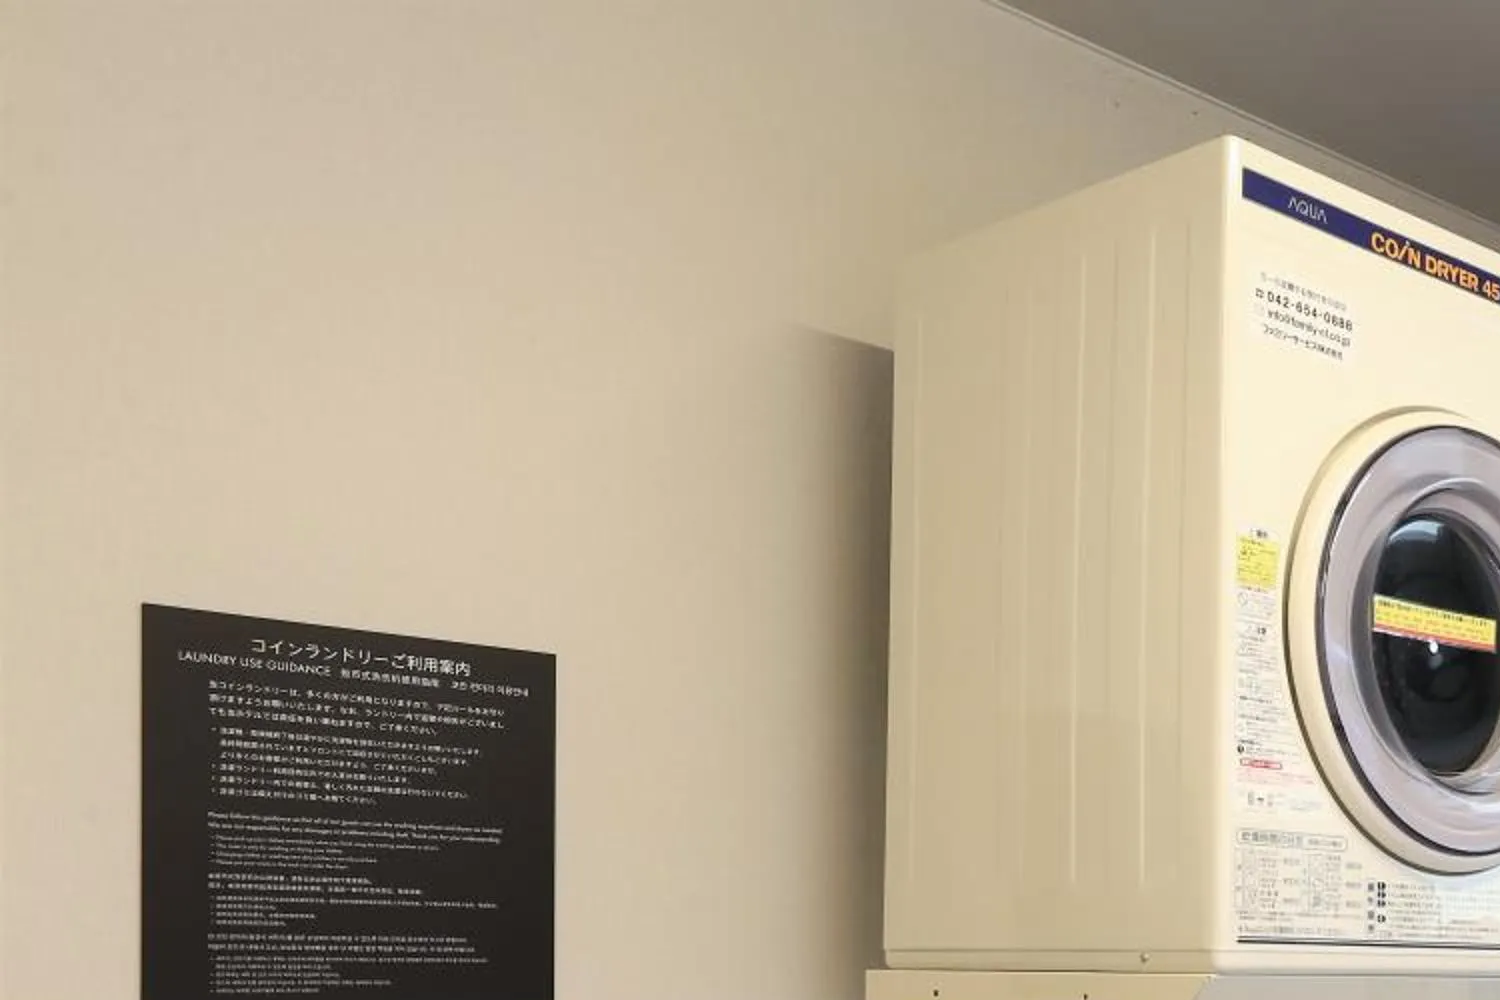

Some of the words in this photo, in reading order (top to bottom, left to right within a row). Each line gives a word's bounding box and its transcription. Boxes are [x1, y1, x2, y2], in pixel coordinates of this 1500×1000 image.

[1287, 196, 1328, 224] AQUA
[1425, 255, 1479, 291] DRYER
[1482, 279, 1500, 301] 45
[177, 650, 238, 666] LAUNDRY
[239, 657, 263, 669] USE
[267, 659, 332, 677] GUIDANCE
[251, 638, 472, 677] コインランドリーご利用案内
